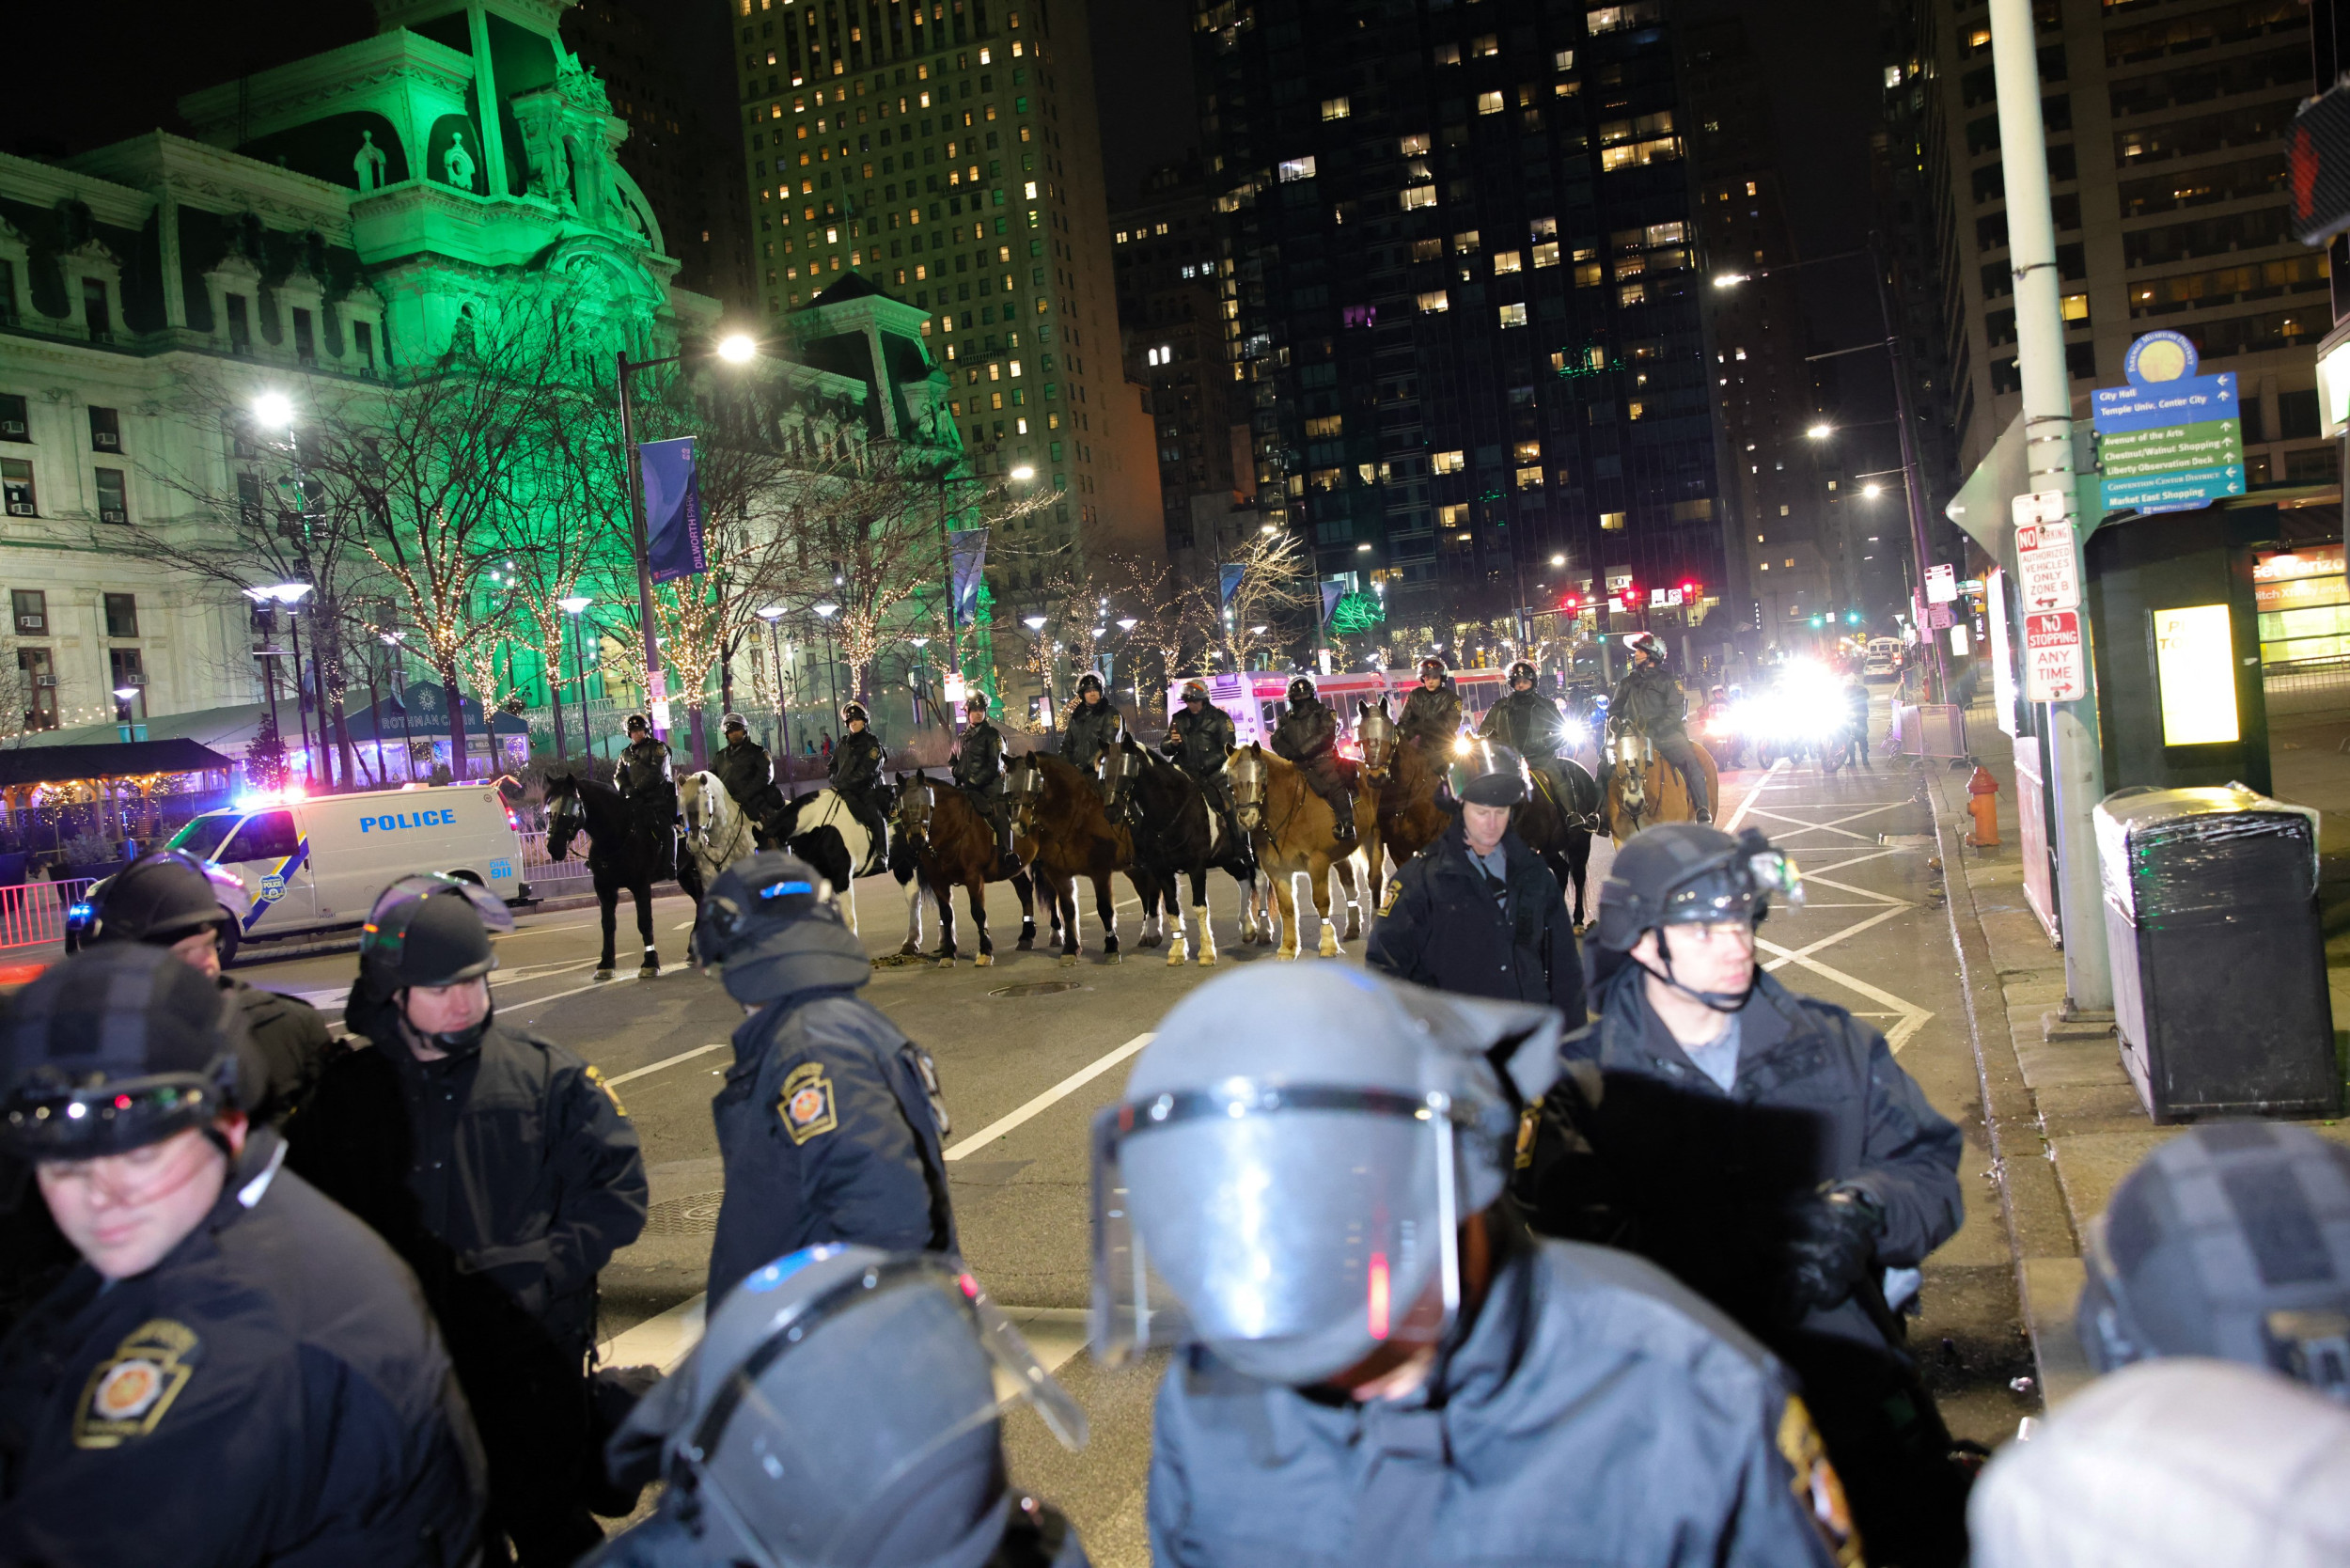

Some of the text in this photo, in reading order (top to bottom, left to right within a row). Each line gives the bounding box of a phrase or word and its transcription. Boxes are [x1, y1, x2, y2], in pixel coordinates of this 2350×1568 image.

[2099, 388, 2137, 401] City Hall
[2101, 395, 2207, 416] Temple Univ. Center City
[2105, 430, 2184, 446] Avenue of the Arts
[2105, 441, 2220, 461] Chestnut/Walnut Shopping
[2107, 455, 2214, 476] Liberty Observation Deck
[2185, 472, 2220, 482] DISTRICT
[2109, 488, 2205, 506] Market East Shopping
[2020, 527, 2067, 550] NO PARKING
[2023, 548, 2070, 563] AUTHORIZED
[2025, 558, 2070, 573] VEHICLES
[2033, 572, 2061, 584] ONLY
[2030, 581, 2069, 595] ZONE B
[2042, 615, 2061, 633] NO
[2030, 631, 2076, 647] STOPPING
[2038, 651, 2070, 665] ANY
[2038, 666, 2072, 680] TIME
[382, 714, 439, 729] ROTHMAN
[360, 809, 457, 833] POLICE
[490, 859, 511, 869] DIAL
[491, 867, 512, 880] 911
[263, 881, 282, 889] POLICE
